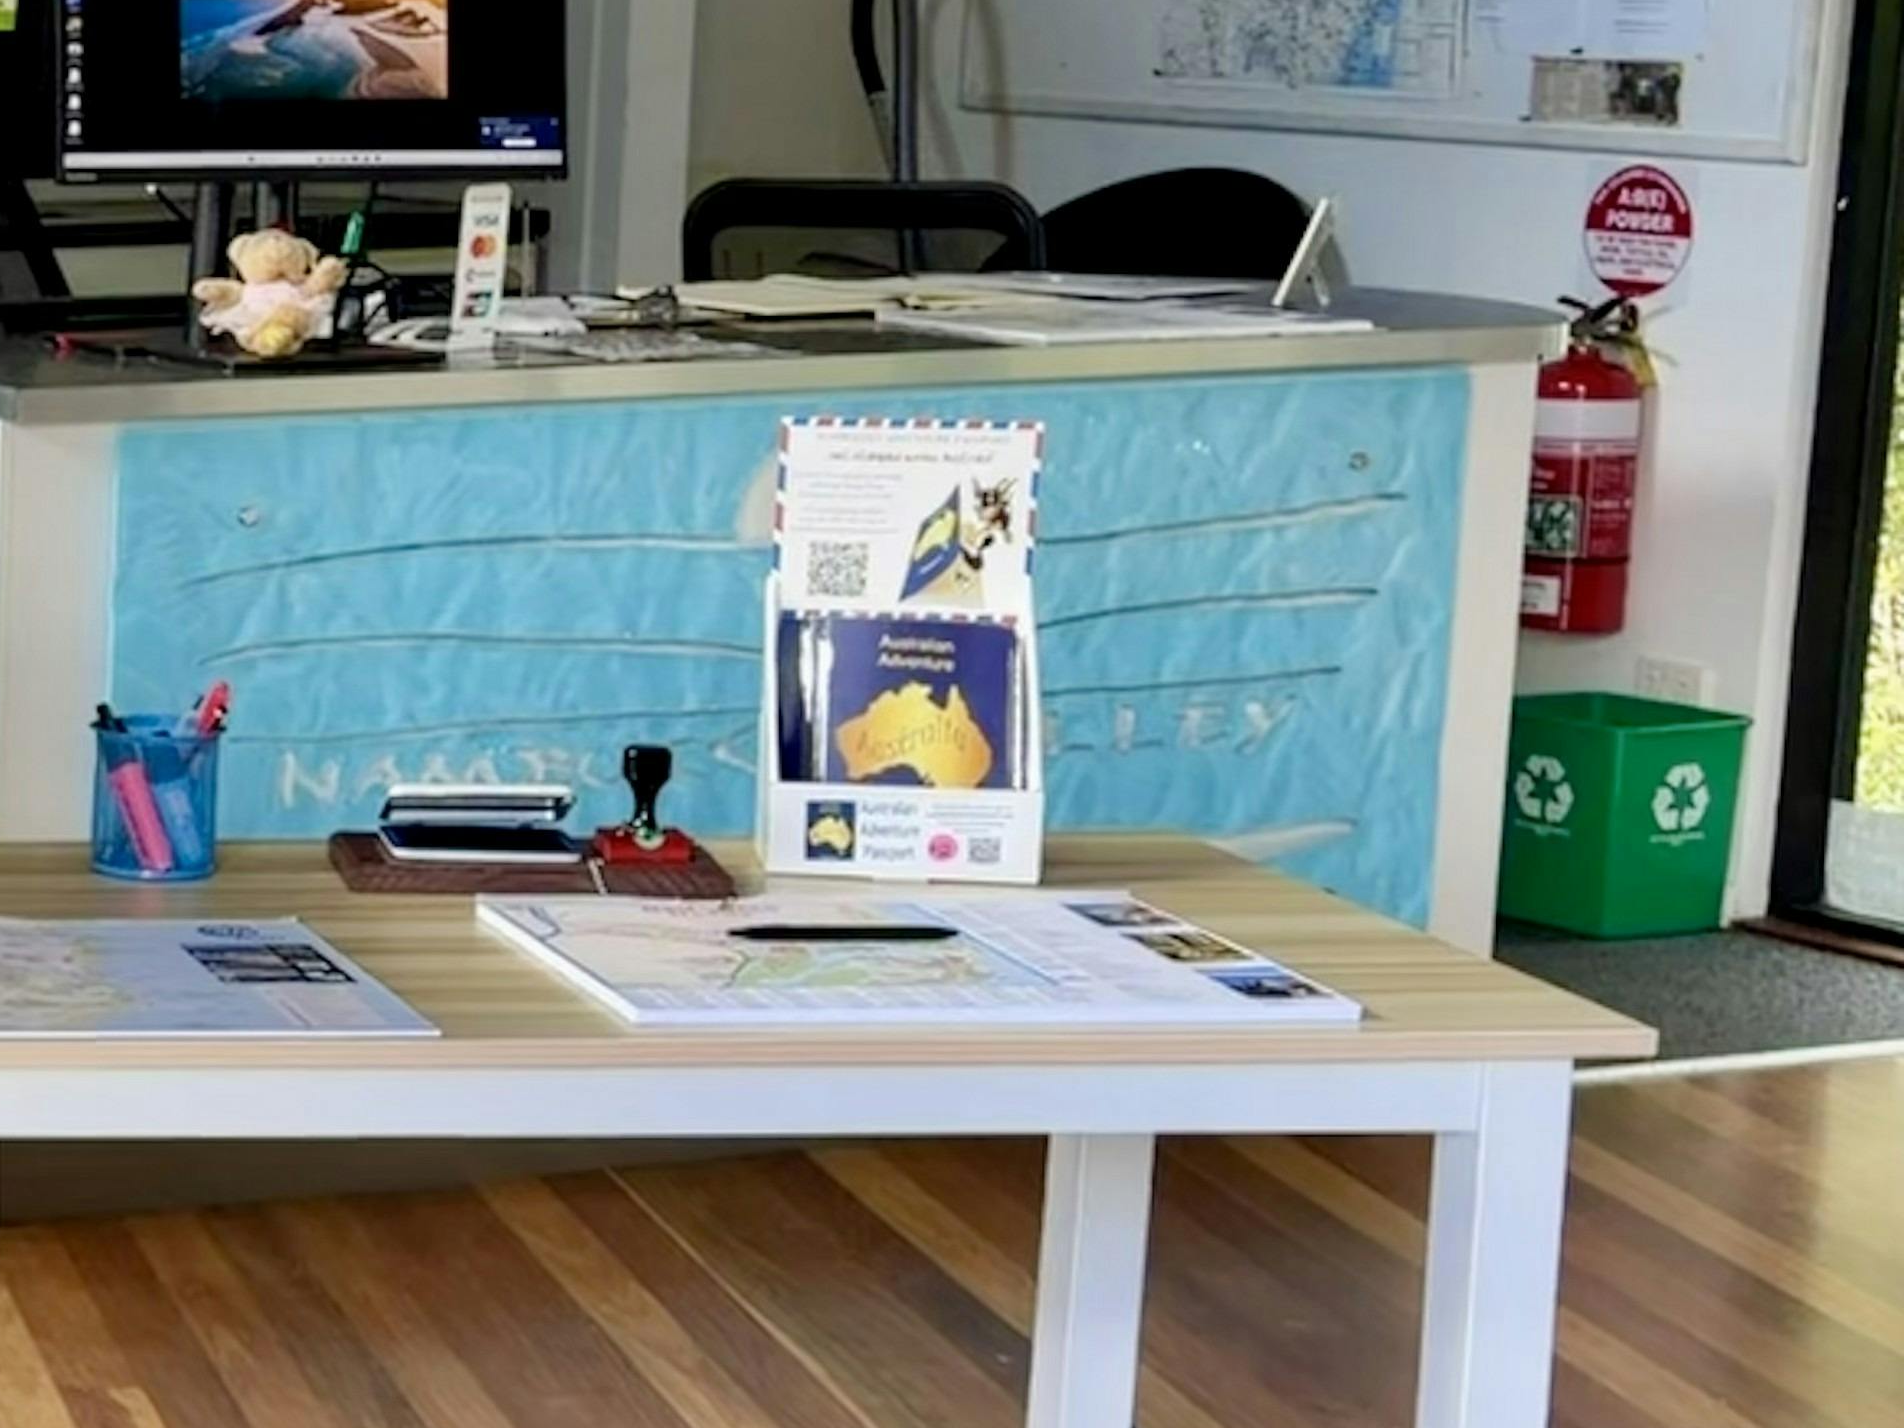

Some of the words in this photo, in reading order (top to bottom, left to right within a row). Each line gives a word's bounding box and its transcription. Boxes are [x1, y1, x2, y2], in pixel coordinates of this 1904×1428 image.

[1604, 208, 1676, 233] POWDER
[875, 631, 957, 656] Australian
[875, 651, 958, 674] Adventure
[855, 712, 971, 759] Australia
[860, 799, 920, 818] Australian
[859, 822, 921, 840] Adventure
